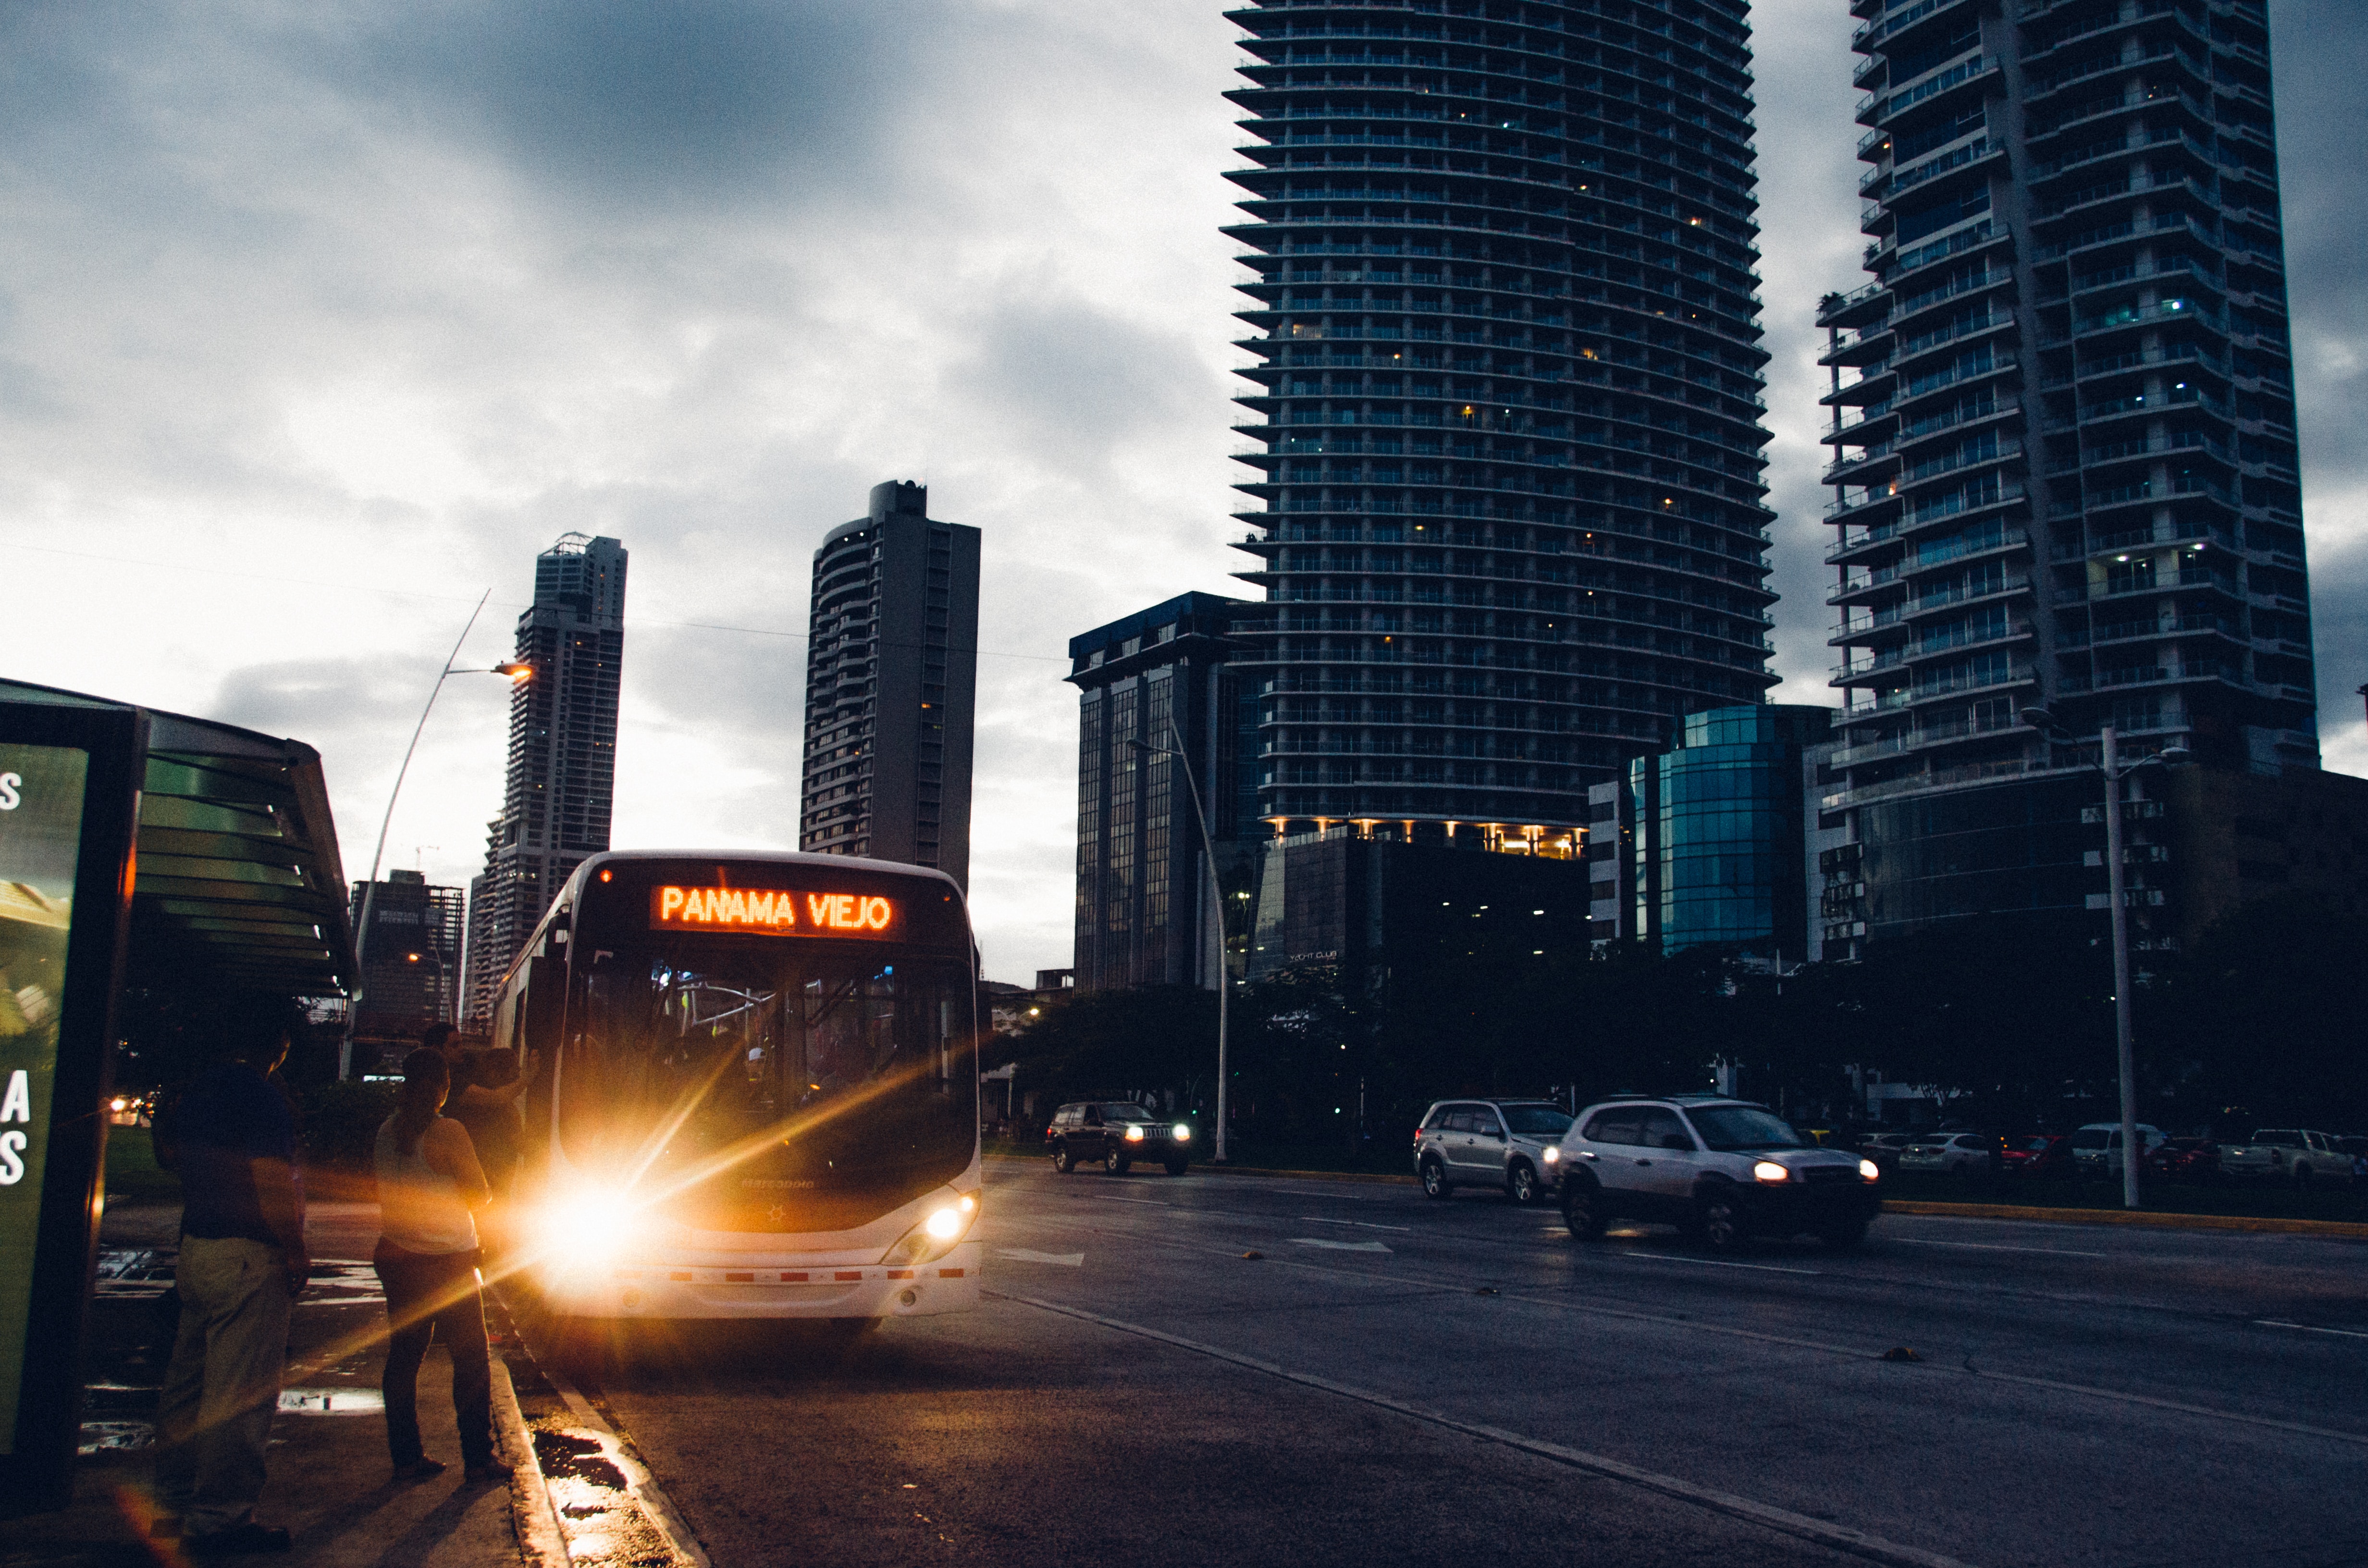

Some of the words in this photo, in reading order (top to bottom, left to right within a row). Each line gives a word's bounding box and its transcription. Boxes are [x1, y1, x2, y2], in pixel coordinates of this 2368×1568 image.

[662, 887, 795, 925] PANAMA
[808, 893, 891, 930] VIEJO
[0, 1070, 30, 1123] A
